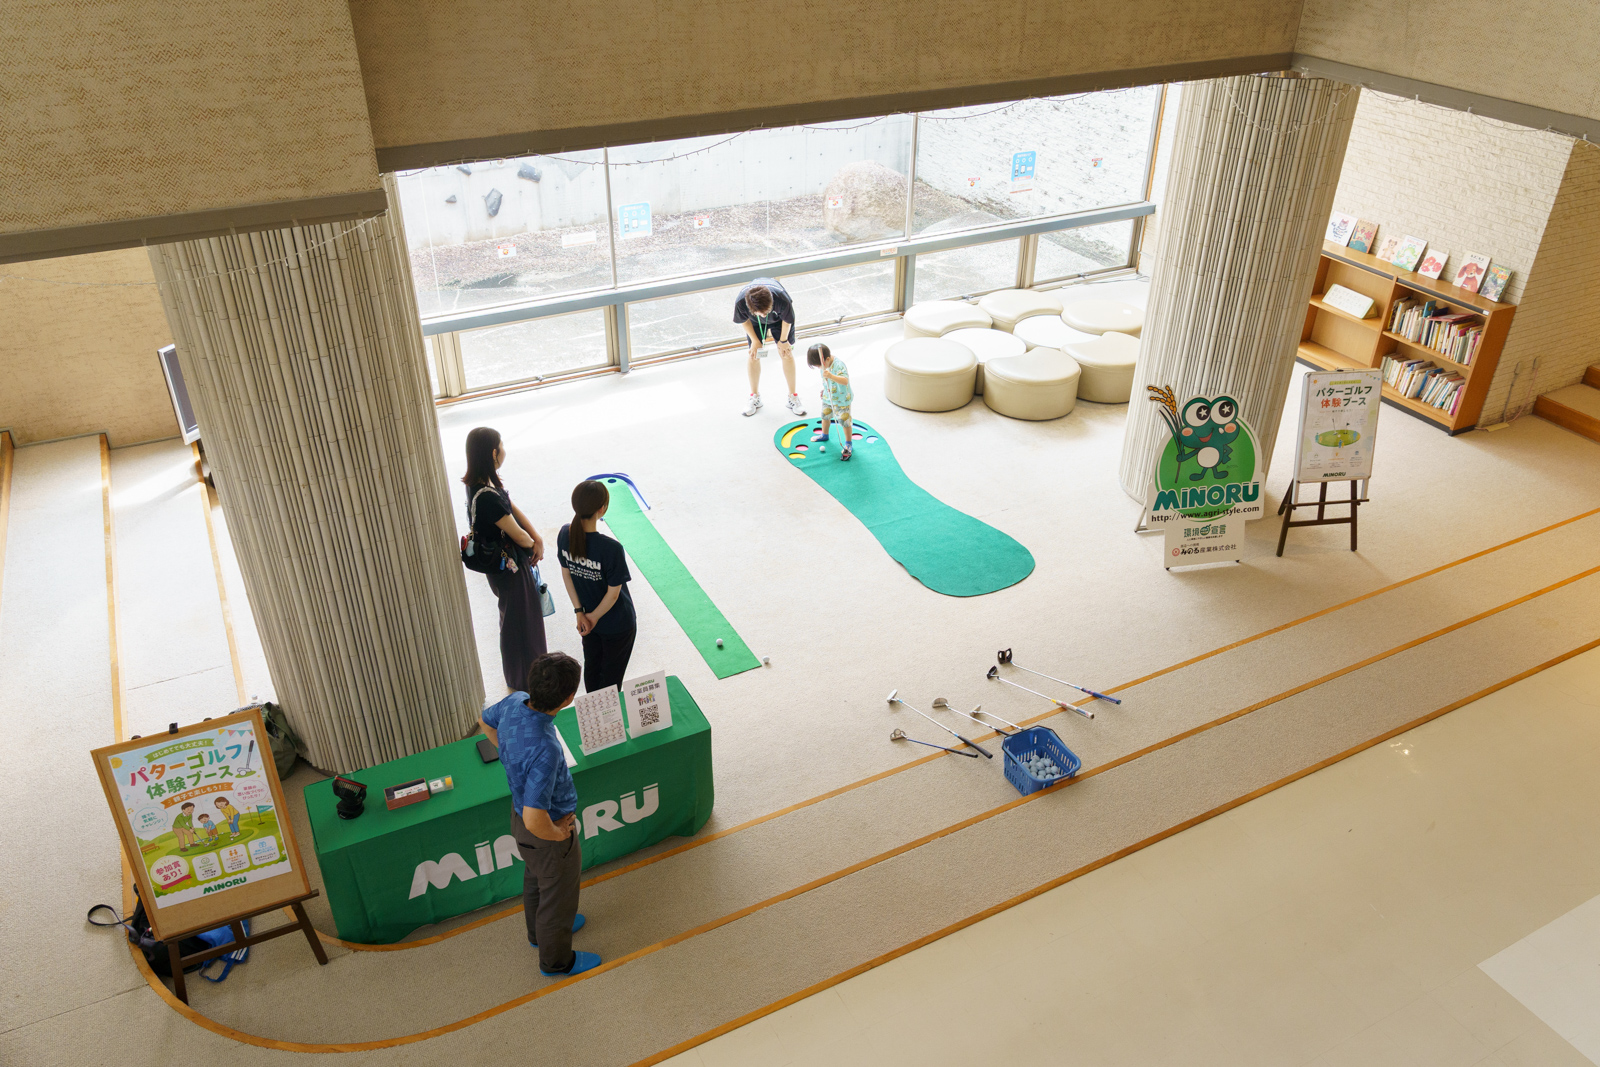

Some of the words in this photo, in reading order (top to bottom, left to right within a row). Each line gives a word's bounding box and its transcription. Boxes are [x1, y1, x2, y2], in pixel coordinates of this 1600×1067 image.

[1316, 386, 1373, 397] パターゴルフ
[1321, 397, 1366, 409] 体験ブース
[1151, 505, 1260, 523] http://www.agri-style.com
[130, 744, 242, 787] パターゴルフ
[146, 765, 234, 800] 体験ブース
[408, 783, 660, 900] MINRU
[155, 860, 181, 876] 参加賞
[203, 876, 247, 895] MINORU
